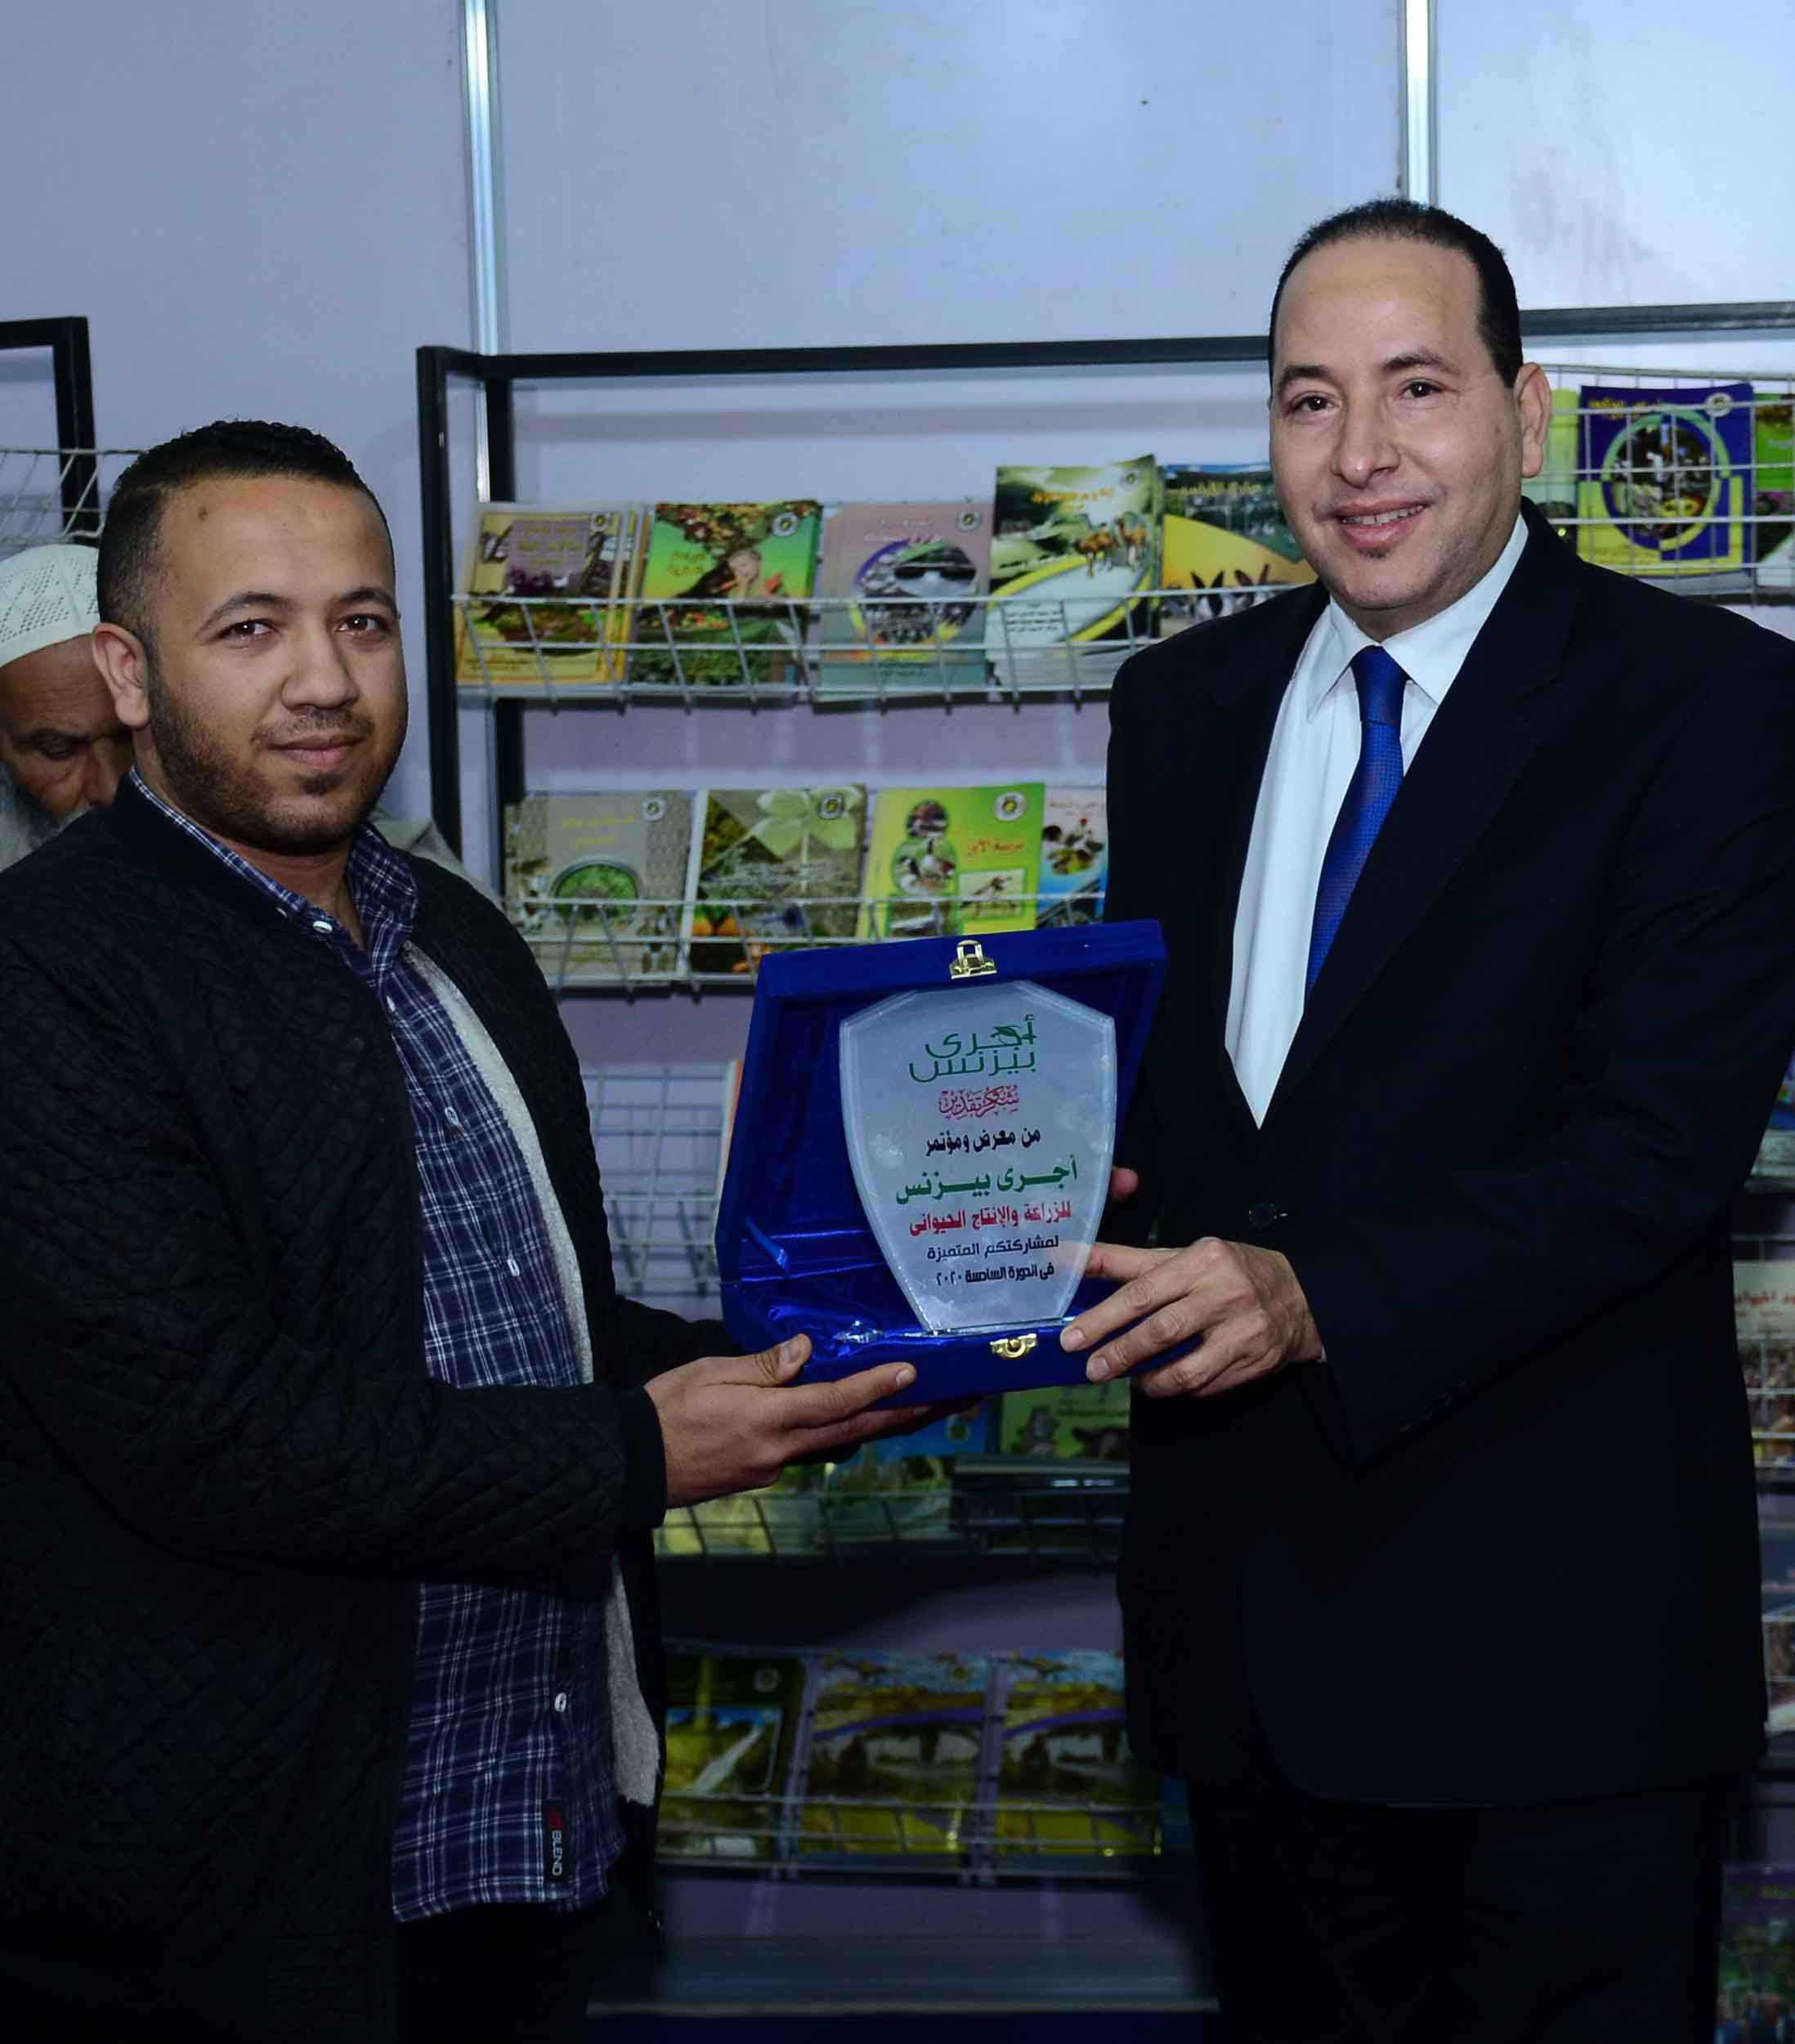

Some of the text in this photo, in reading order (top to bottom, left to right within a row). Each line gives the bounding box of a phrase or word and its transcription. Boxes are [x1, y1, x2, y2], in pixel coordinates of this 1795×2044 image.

[909, 1047, 1036, 1083] بيزنس
[925, 1127, 1041, 1157] من معرض ومؤتمر
[896, 1154, 1078, 1205] أجرى بيزنس
[909, 1209, 967, 1237] الحيوانى
[1023, 1199, 1073, 1223] للزراعة
[927, 1234, 1059, 1263] لمشاركتكم المتميزة
[936, 1261, 1055, 1286] فى الدورة السادسة ٢٠٢٠
[551, 1830, 564, 1876] BLEND
